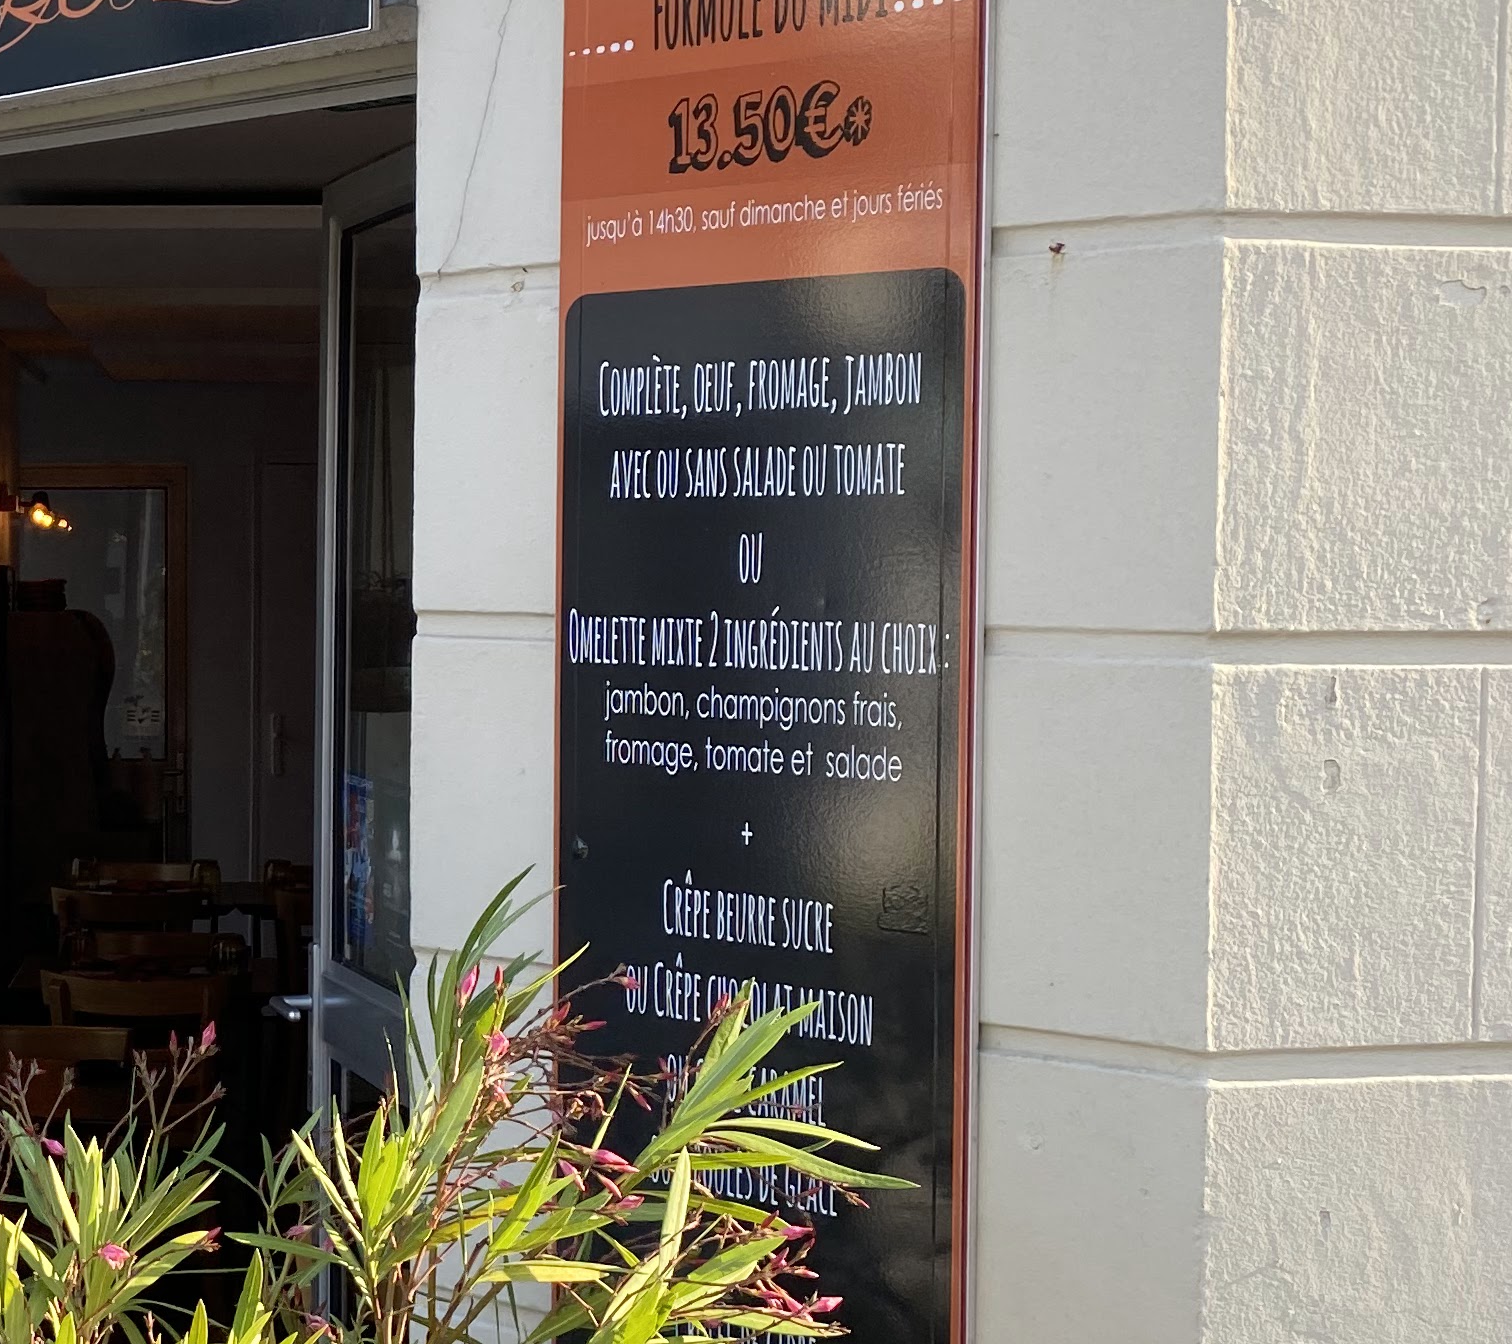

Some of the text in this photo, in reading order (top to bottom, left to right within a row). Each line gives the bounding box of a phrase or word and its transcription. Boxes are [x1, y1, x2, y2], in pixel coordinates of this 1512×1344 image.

[586, 183, 944, 247] jusqu'à 14h30, sauf dimanche et jours fériés
[600, 352, 922, 419] COMPLÈTE, OEUF, FROMAGE, JAMBON
[610, 442, 906, 500] AVEC OU SANS SALADE OU TOMATE
[739, 532, 763, 584] OU
[569, 608, 646, 666] OMELETTE
[652, 617, 703, 668] MIXTE
[708, 610, 719, 668] 2
[724, 605, 843, 673] INGRÉDIENTS
[849, 621, 875, 673] AU
[881, 622, 938, 675] CHOIX
[604, 681, 903, 730] jambon, champignons frais,
[604, 731, 902, 782] fromage, tomate et salade
[662, 869, 834, 954] CRÊPE BEURRE SUCRE
[626, 964, 648, 1014] OU
[654, 951, 702, 1023] CRÊPE
[799, 987, 873, 1047] MAISON
